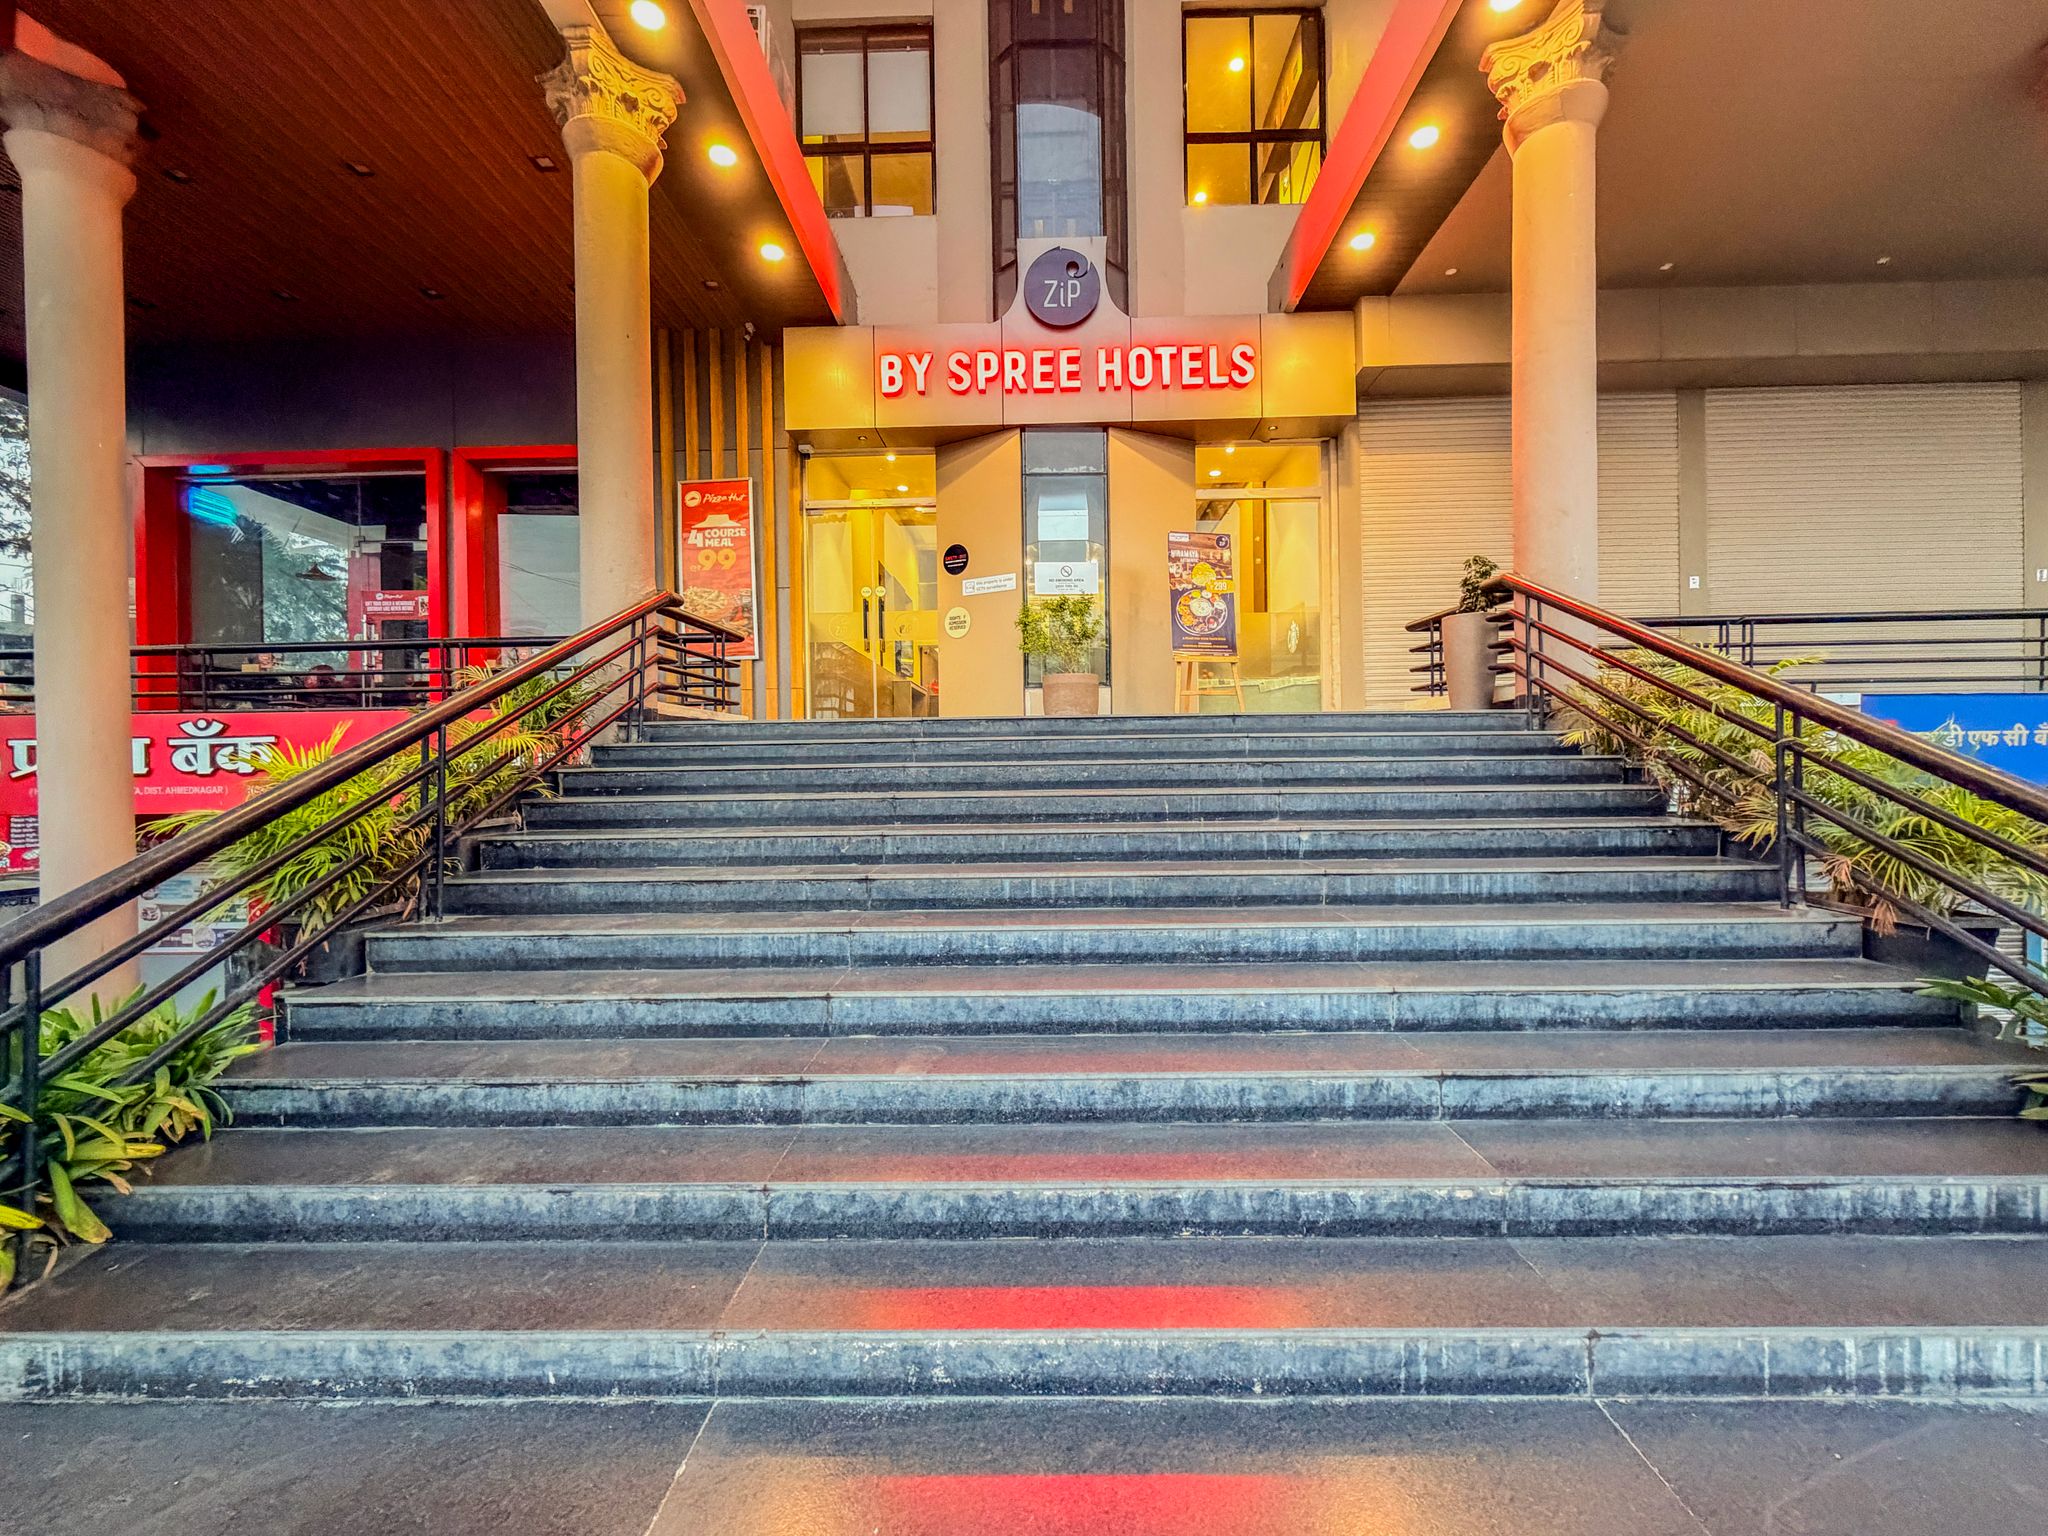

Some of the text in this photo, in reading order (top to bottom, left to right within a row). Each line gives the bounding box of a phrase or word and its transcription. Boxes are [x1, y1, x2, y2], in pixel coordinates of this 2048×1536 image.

[880, 344, 1256, 396] BY SPREE HOTELS
[703, 492, 748, 503] Pizza Hut
[688, 528, 746, 547] 4 COURSE
[704, 538, 734, 547] MEAL
[165, 786, 223, 795] AHMEDNAGAR
